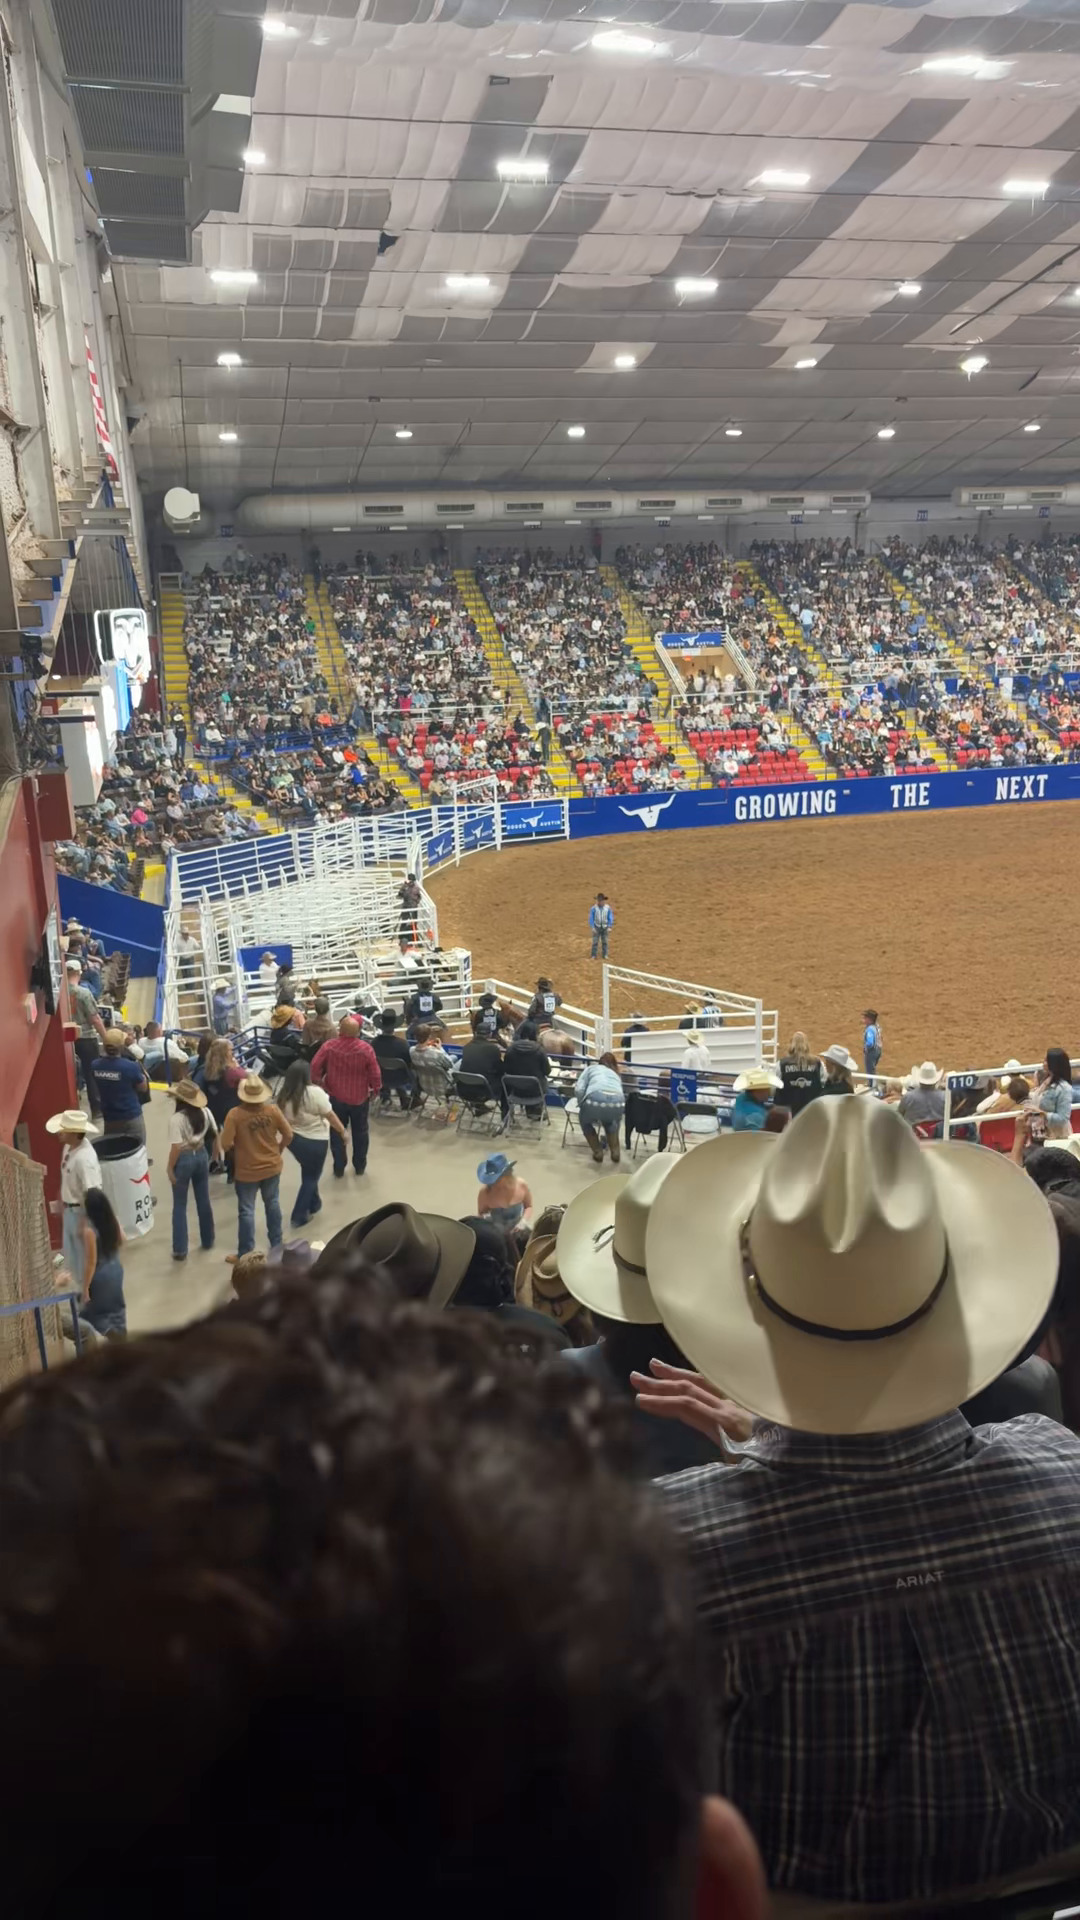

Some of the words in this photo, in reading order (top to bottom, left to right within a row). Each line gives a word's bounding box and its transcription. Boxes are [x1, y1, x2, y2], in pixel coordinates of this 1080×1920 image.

[735, 789, 836, 820] GROWING
[890, 782, 930, 808] THE
[995, 774, 1049, 800] NEXT
[951, 1075, 974, 1089] 110
[896, 1570, 945, 1590] ARIAT
